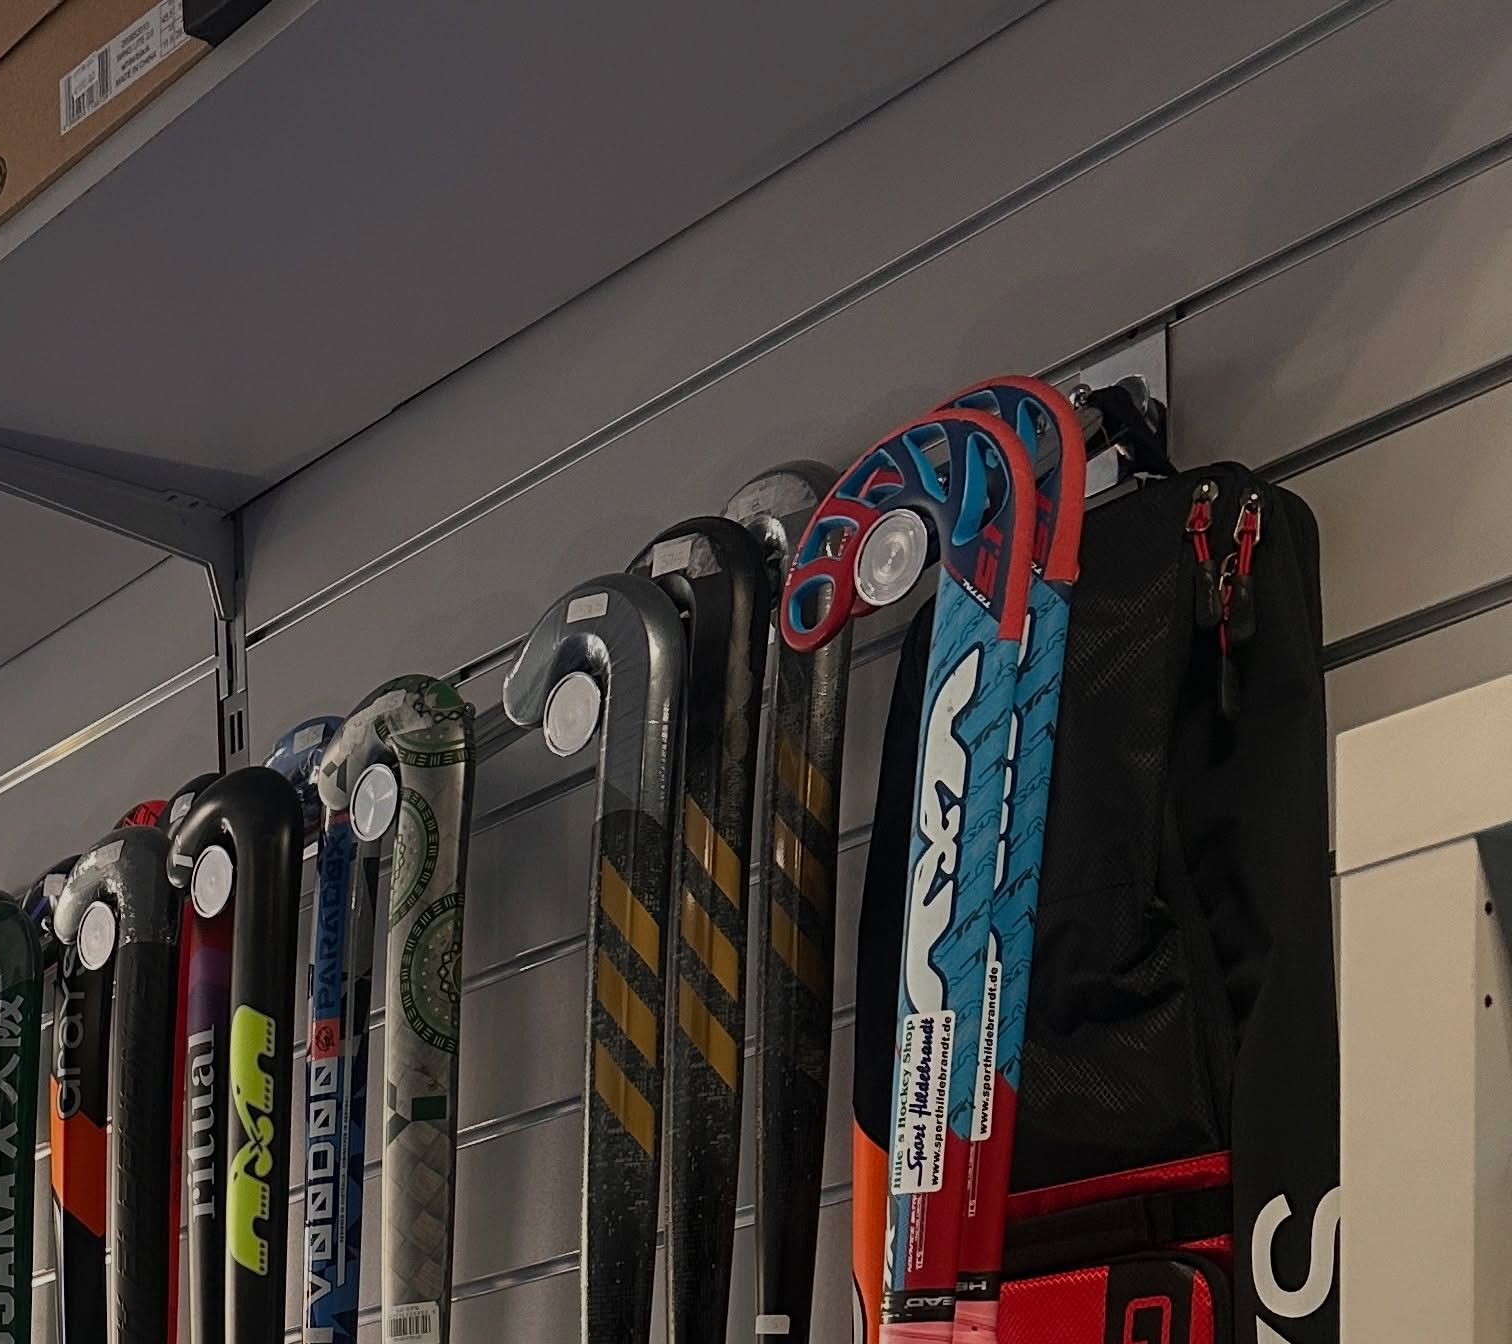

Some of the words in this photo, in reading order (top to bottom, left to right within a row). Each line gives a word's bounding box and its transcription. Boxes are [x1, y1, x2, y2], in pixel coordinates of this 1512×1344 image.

[902, 1020, 915, 1063] Shop
[908, 1017, 935, 1118] Hildebrandt
[979, 966, 999, 1136] www.sporthildebrandt.de
[188, 1024, 216, 1220] ritual
[896, 1068, 911, 1130] Hockey
[930, 1015, 952, 1187] www.sporthildebrandt.de
[907, 1123, 927, 1187] Sport
